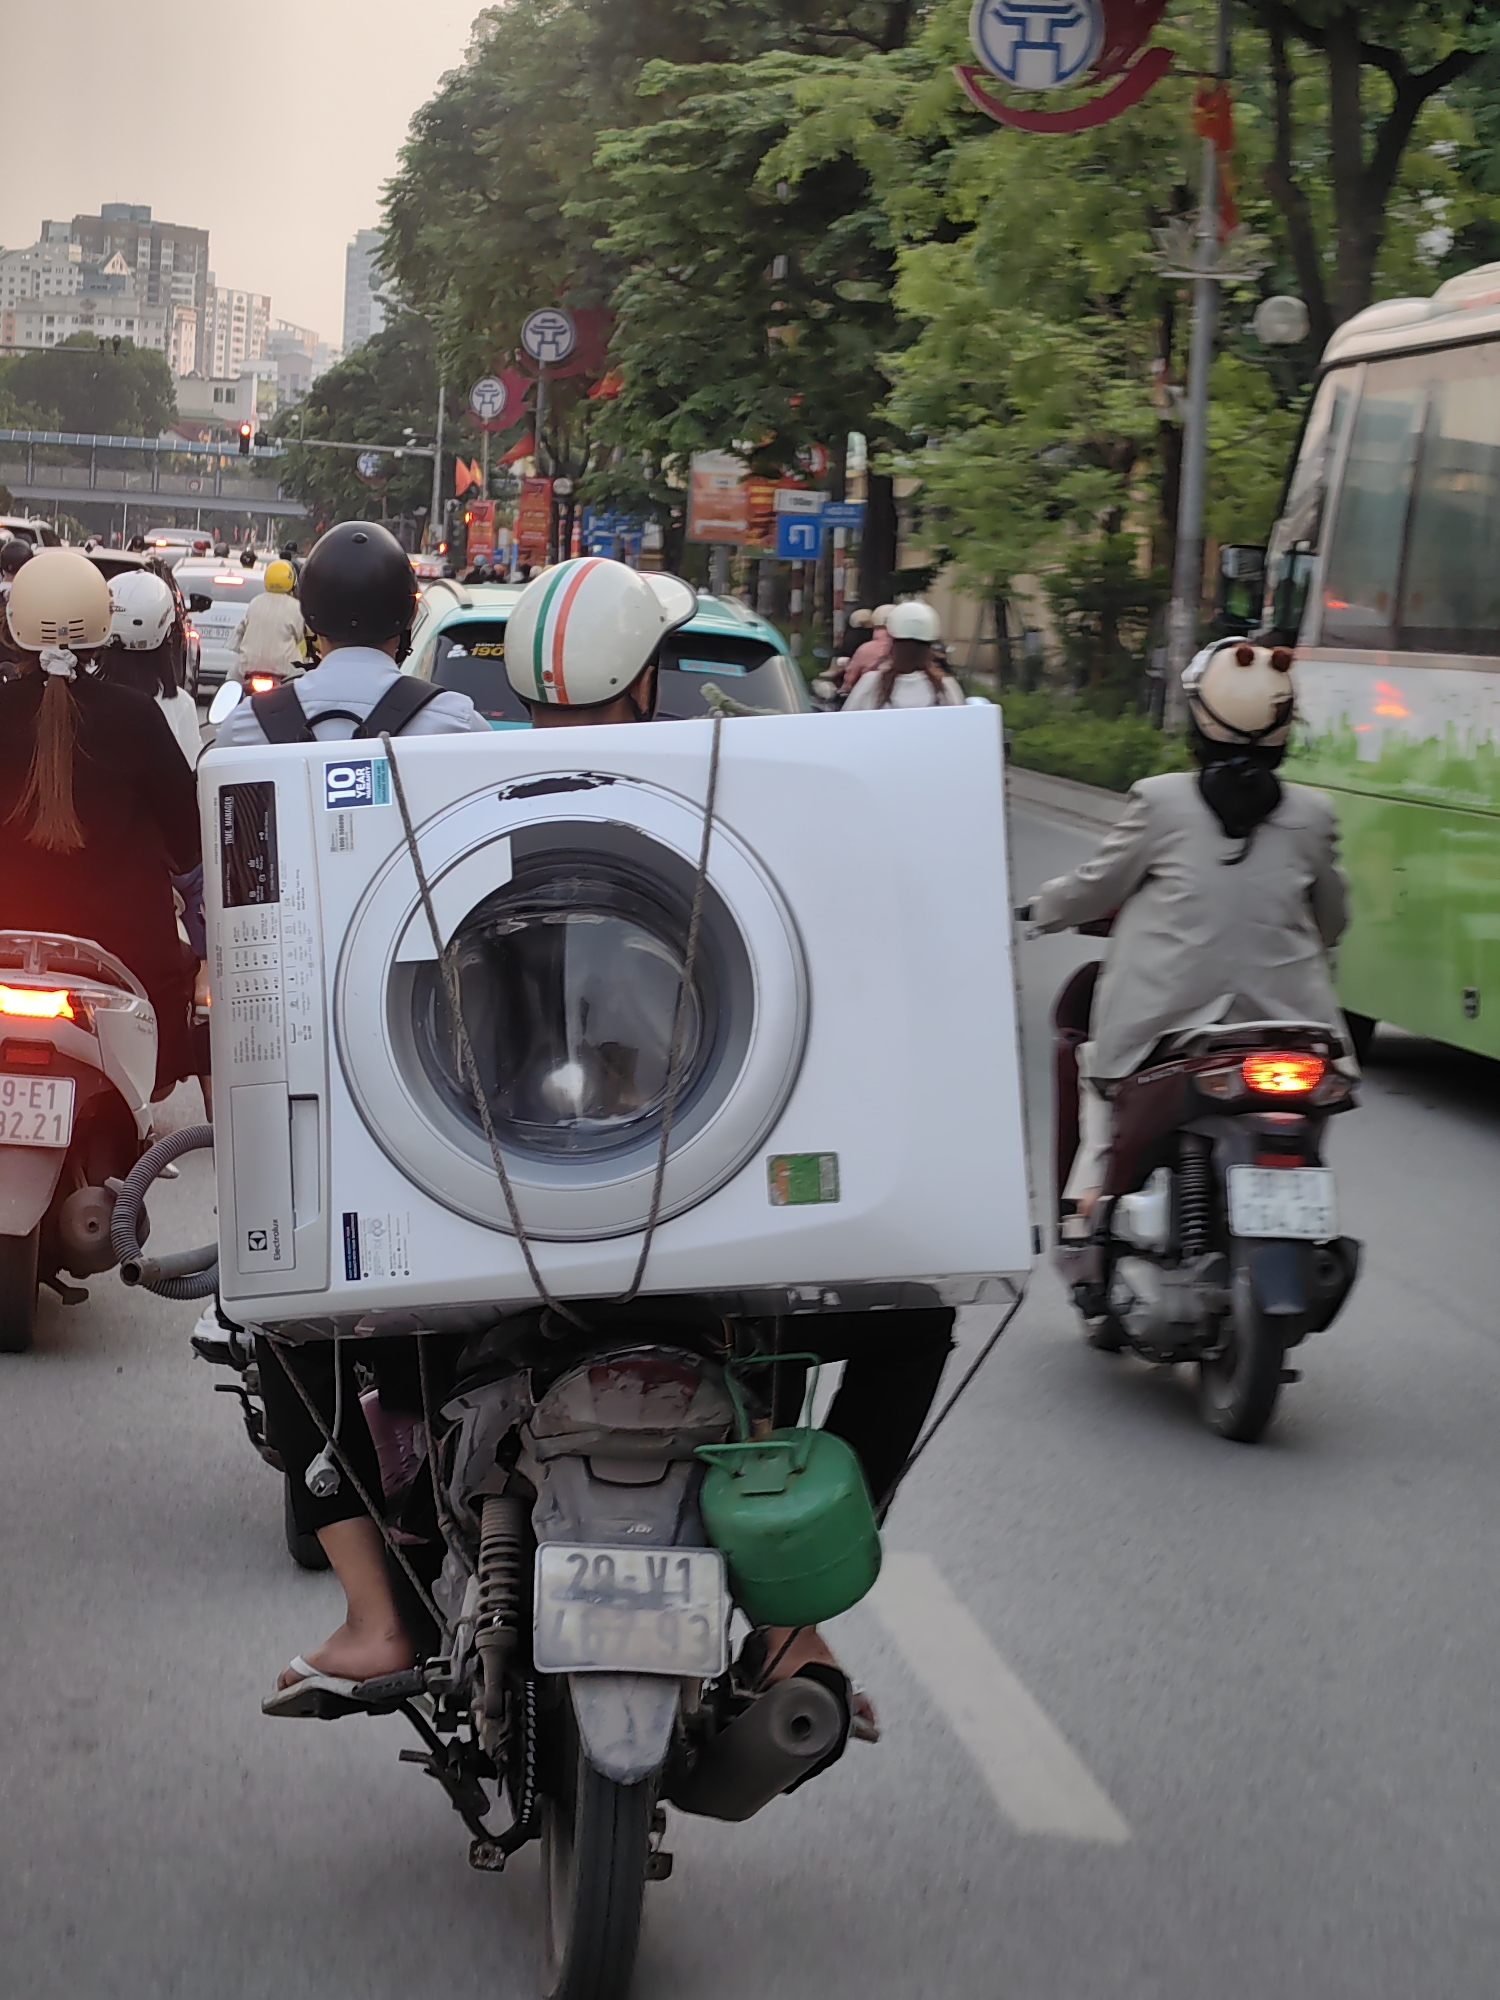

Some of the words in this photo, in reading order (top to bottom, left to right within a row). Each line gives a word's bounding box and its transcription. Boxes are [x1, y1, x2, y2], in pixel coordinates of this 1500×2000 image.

[327, 767, 356, 803] 10
[355, 768, 366, 799] YEAR
[224, 796, 234, 826] MANAGER
[225, 829, 235, 845] TIME
[272, 1218, 281, 1261] Electrolux
